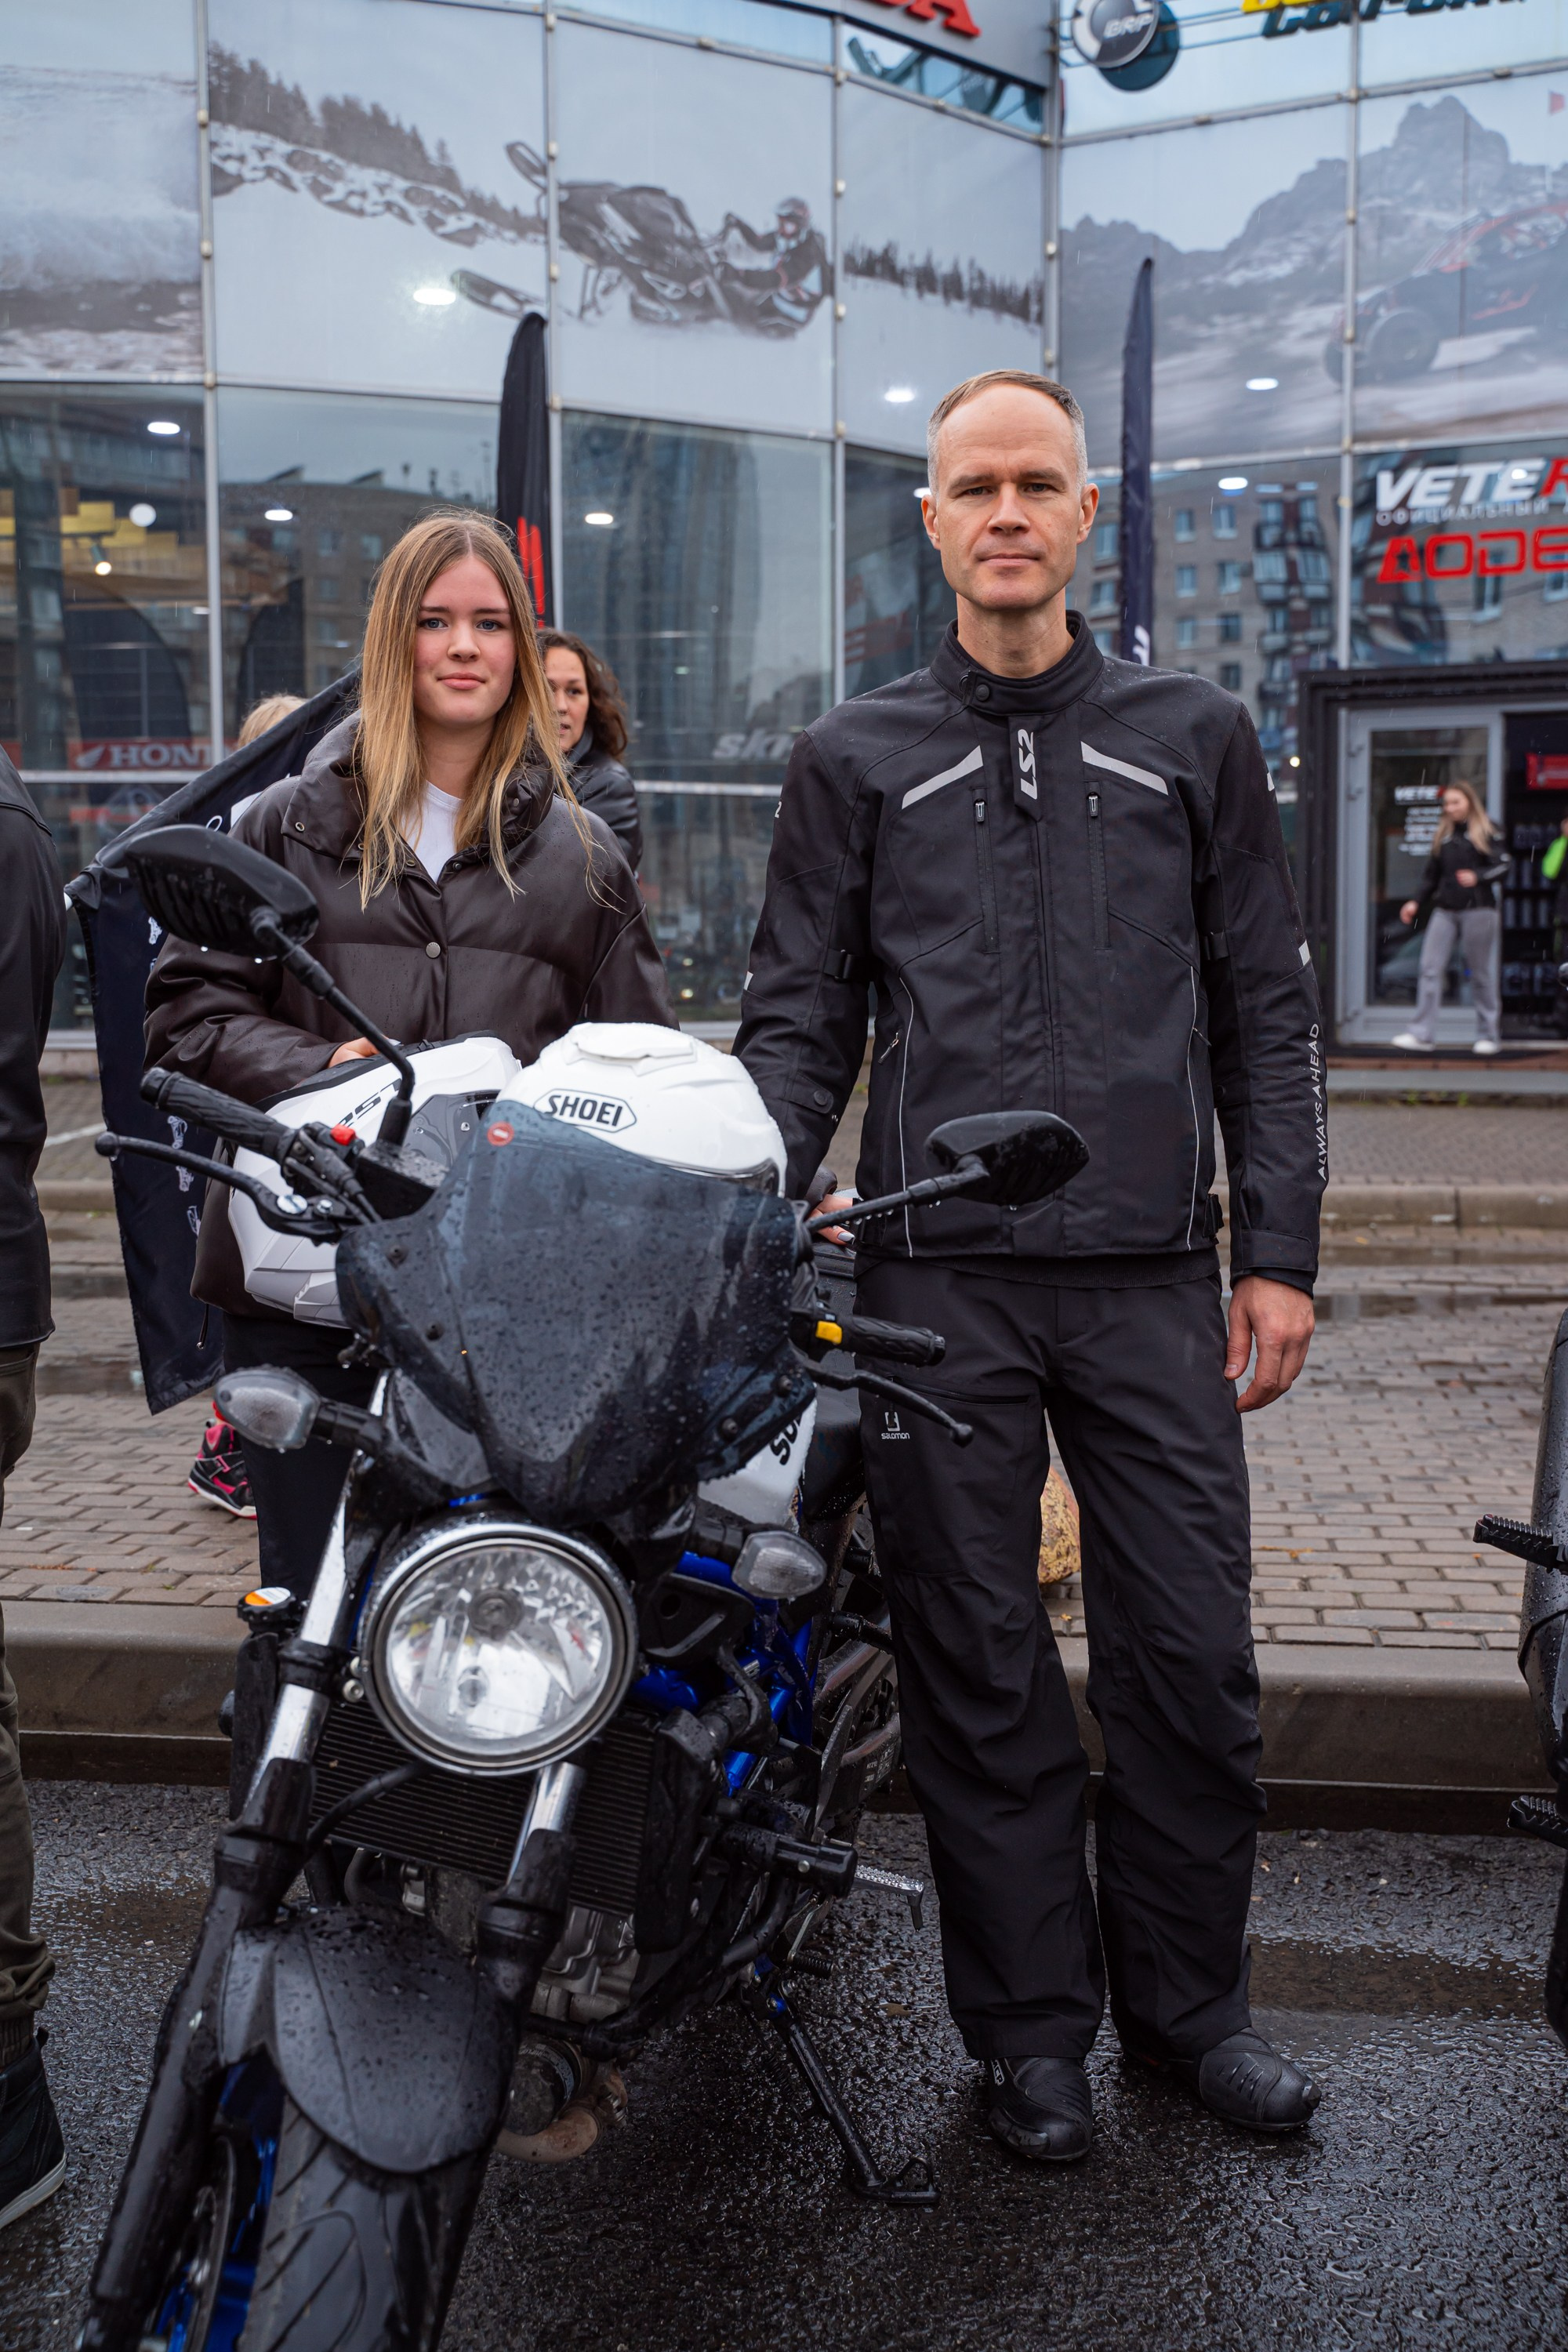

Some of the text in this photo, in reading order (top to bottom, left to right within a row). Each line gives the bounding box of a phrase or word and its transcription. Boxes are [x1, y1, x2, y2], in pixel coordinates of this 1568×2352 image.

[1018, 728, 1038, 800] LS2
[543, 1094, 623, 1127] SHOEI
[1308, 1023, 1327, 1181] ALWAYS AHEAD
[769, 1413, 803, 1466] SU
